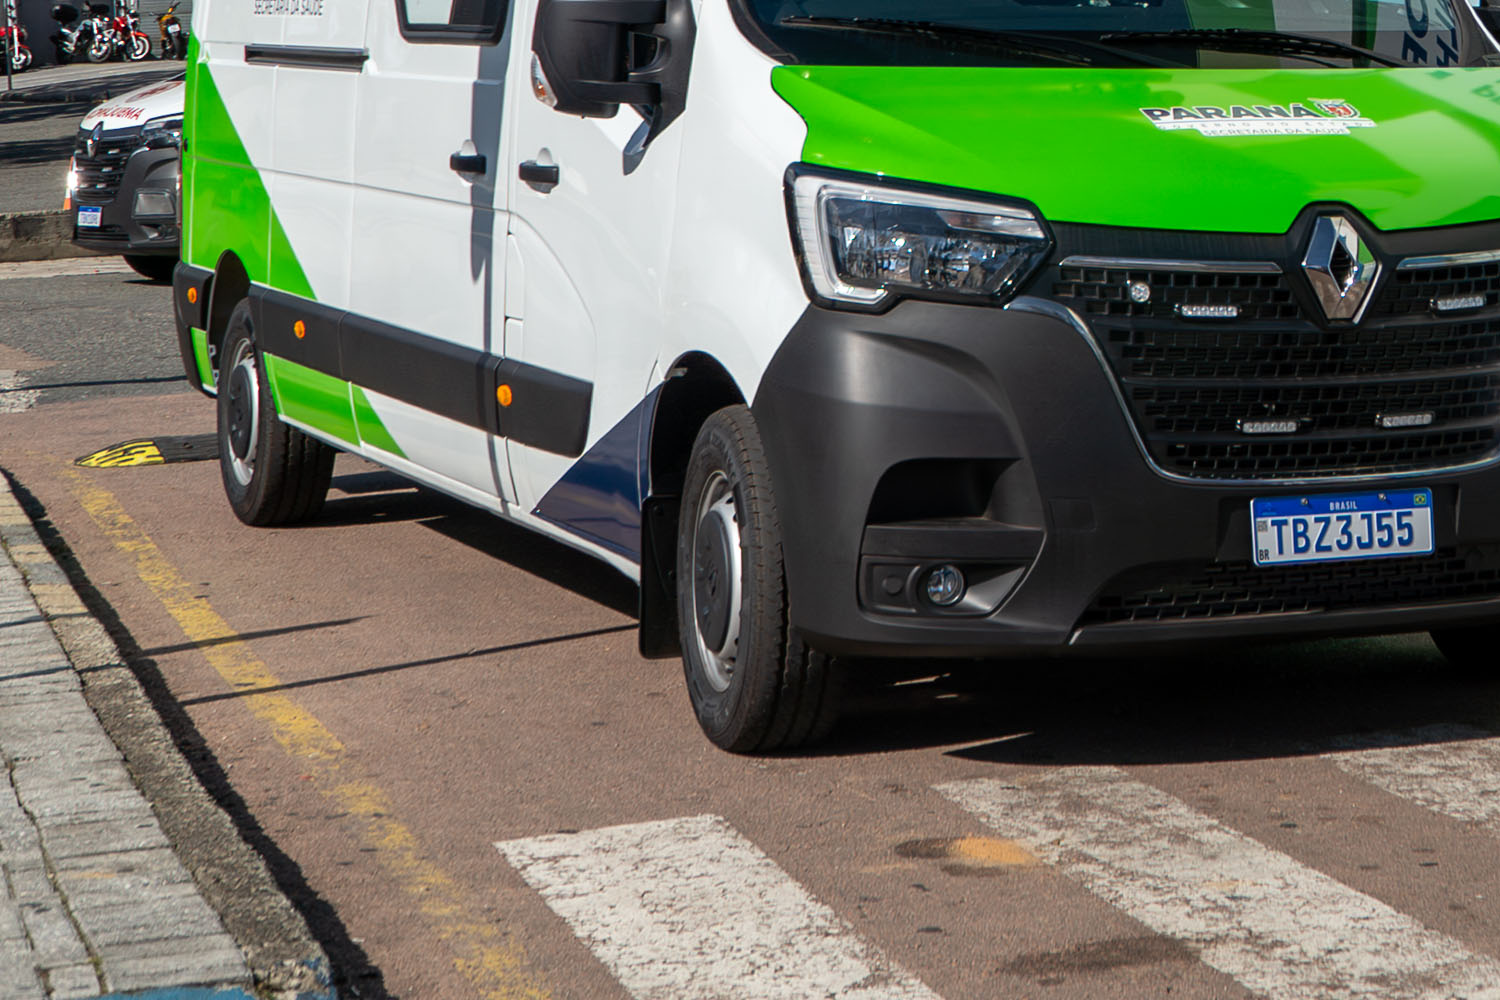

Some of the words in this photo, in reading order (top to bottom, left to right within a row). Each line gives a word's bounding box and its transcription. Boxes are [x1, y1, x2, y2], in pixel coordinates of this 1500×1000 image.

[1141, 104, 1322, 120] PARANÁ
[1329, 500, 1358, 511] BRASIL
[1270, 510, 1415, 556] TBZ3J55
[1258, 549, 1270, 561] BR
